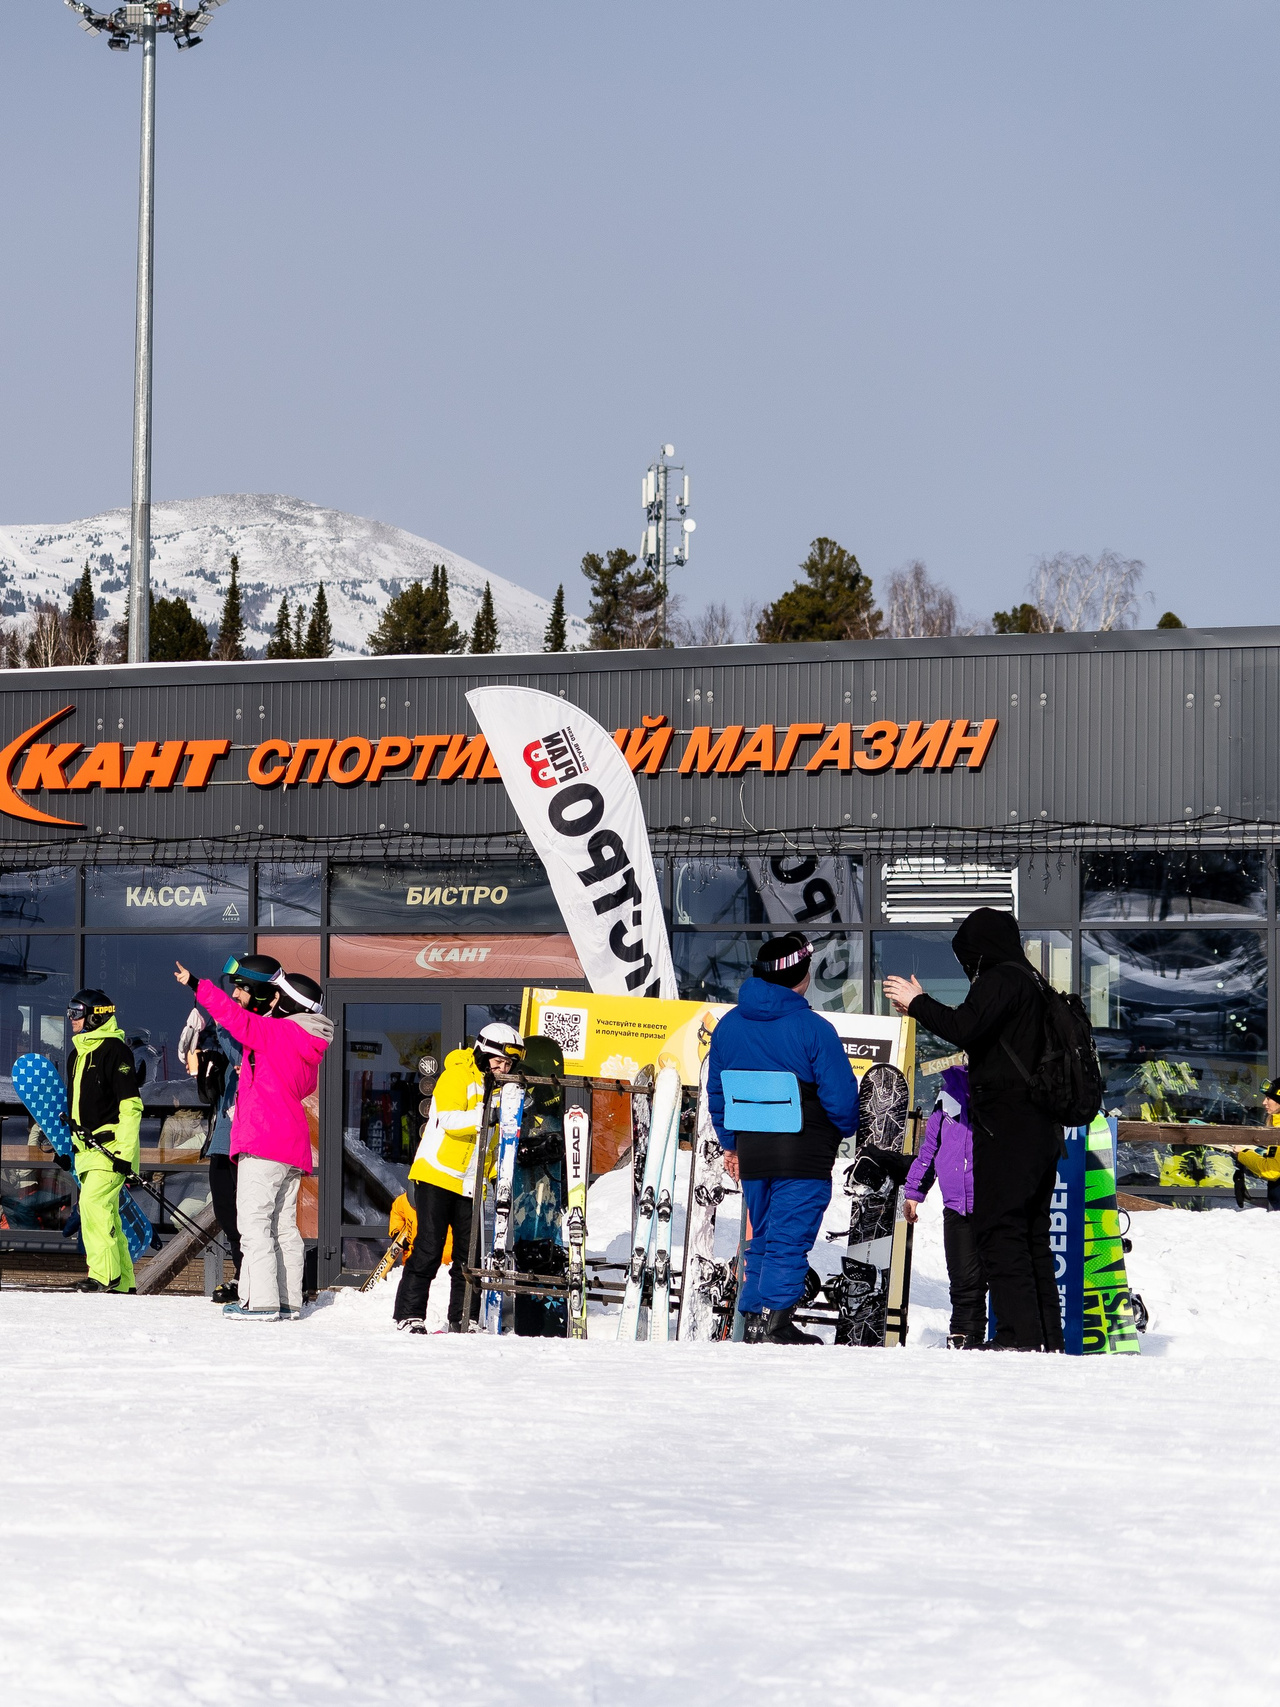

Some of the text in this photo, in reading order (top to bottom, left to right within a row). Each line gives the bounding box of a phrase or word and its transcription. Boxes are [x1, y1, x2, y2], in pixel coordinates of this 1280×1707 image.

[17, 740, 232, 791] КАНТ
[677, 718, 1000, 776] МАГАЗИН
[126, 886, 207, 907] КАССА
[406, 886, 509, 906] БИСТРО
[427, 947, 492, 962] КАНТ
[596, 1018, 636, 1029] Участвуйте
[601, 1029, 639, 1038] получайте
[639, 1032, 666, 1040] призы!
[842, 1043, 880, 1057] ВЕСТ
[928, 1054, 960, 1073] КАНТ
[572, 1126, 581, 1179] HEAD
[364, 1258, 388, 1292] ROSSIGNO
[1103, 1291, 1140, 1354] SAL
